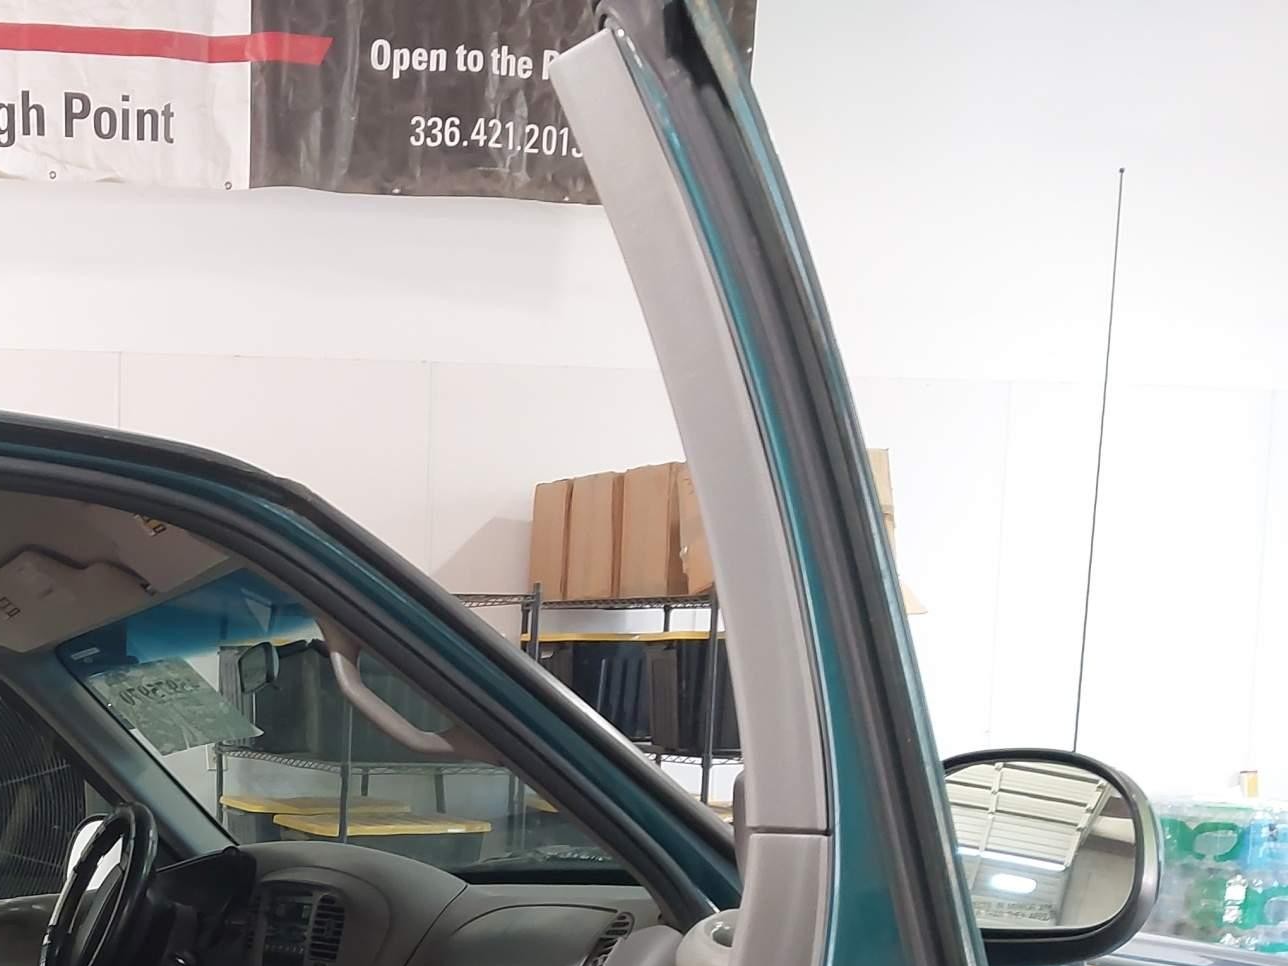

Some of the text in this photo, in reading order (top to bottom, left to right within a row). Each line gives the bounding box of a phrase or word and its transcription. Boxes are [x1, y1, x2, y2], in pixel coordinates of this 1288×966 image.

[370, 39, 447, 79] Open
[456, 44, 484, 72] to
[491, 45, 533, 79] the
[64, 92, 174, 143] Point
